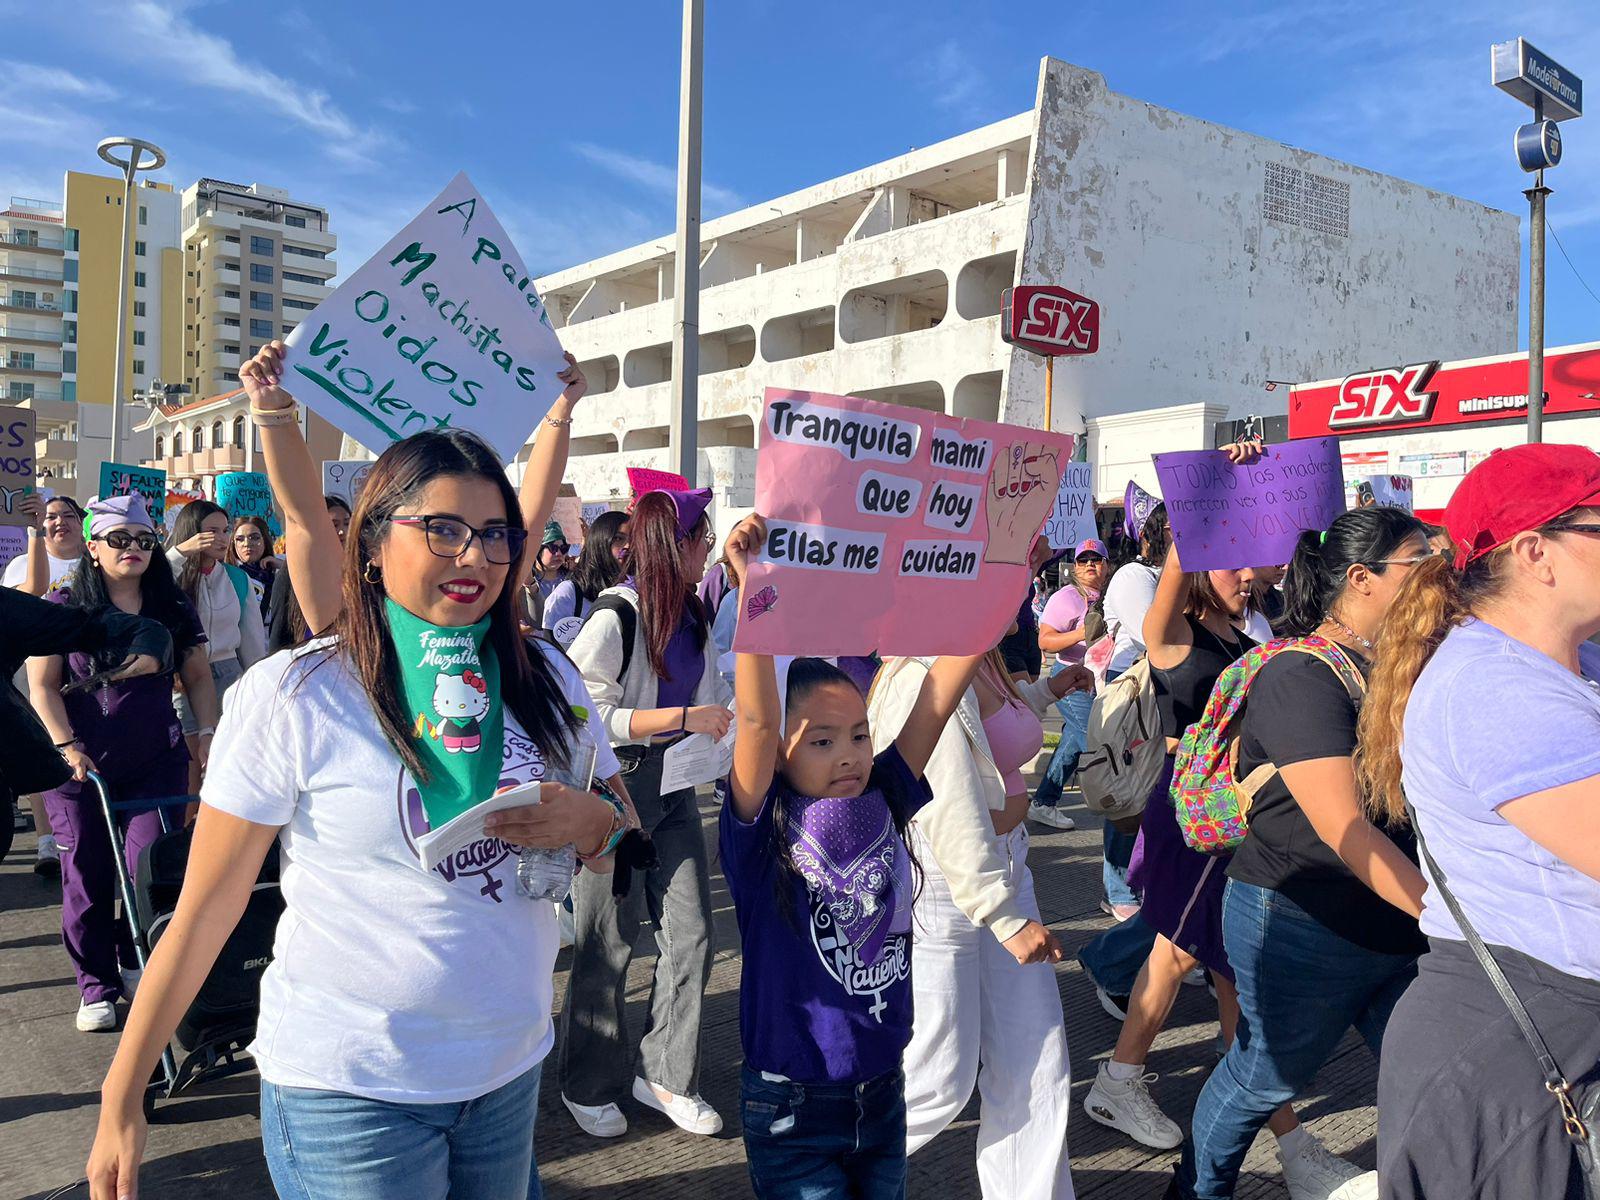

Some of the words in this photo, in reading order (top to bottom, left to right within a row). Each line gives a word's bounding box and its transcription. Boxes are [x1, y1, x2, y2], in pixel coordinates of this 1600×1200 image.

[438, 199, 476, 238] A
[389, 242, 537, 392] Machistas
[355, 290, 483, 407] Oidos
[309, 322, 453, 431] Violent
[770, 402, 913, 459] Tranquila
[931, 438, 987, 469] mami
[1162, 463, 1238, 490] TODAS
[1248, 463, 1275, 488] las
[1282, 454, 1335, 480] madres
[863, 478, 911, 514] Que
[929, 484, 973, 528] hoy
[1058, 493, 1086, 517] HAY
[1234, 495, 1258, 509] ver
[1265, 491, 1277, 505] a
[1282, 485, 1308, 502] sus
[767, 527, 838, 566] Ellas
[843, 543, 880, 570] me
[901, 543, 976, 574] cuidan
